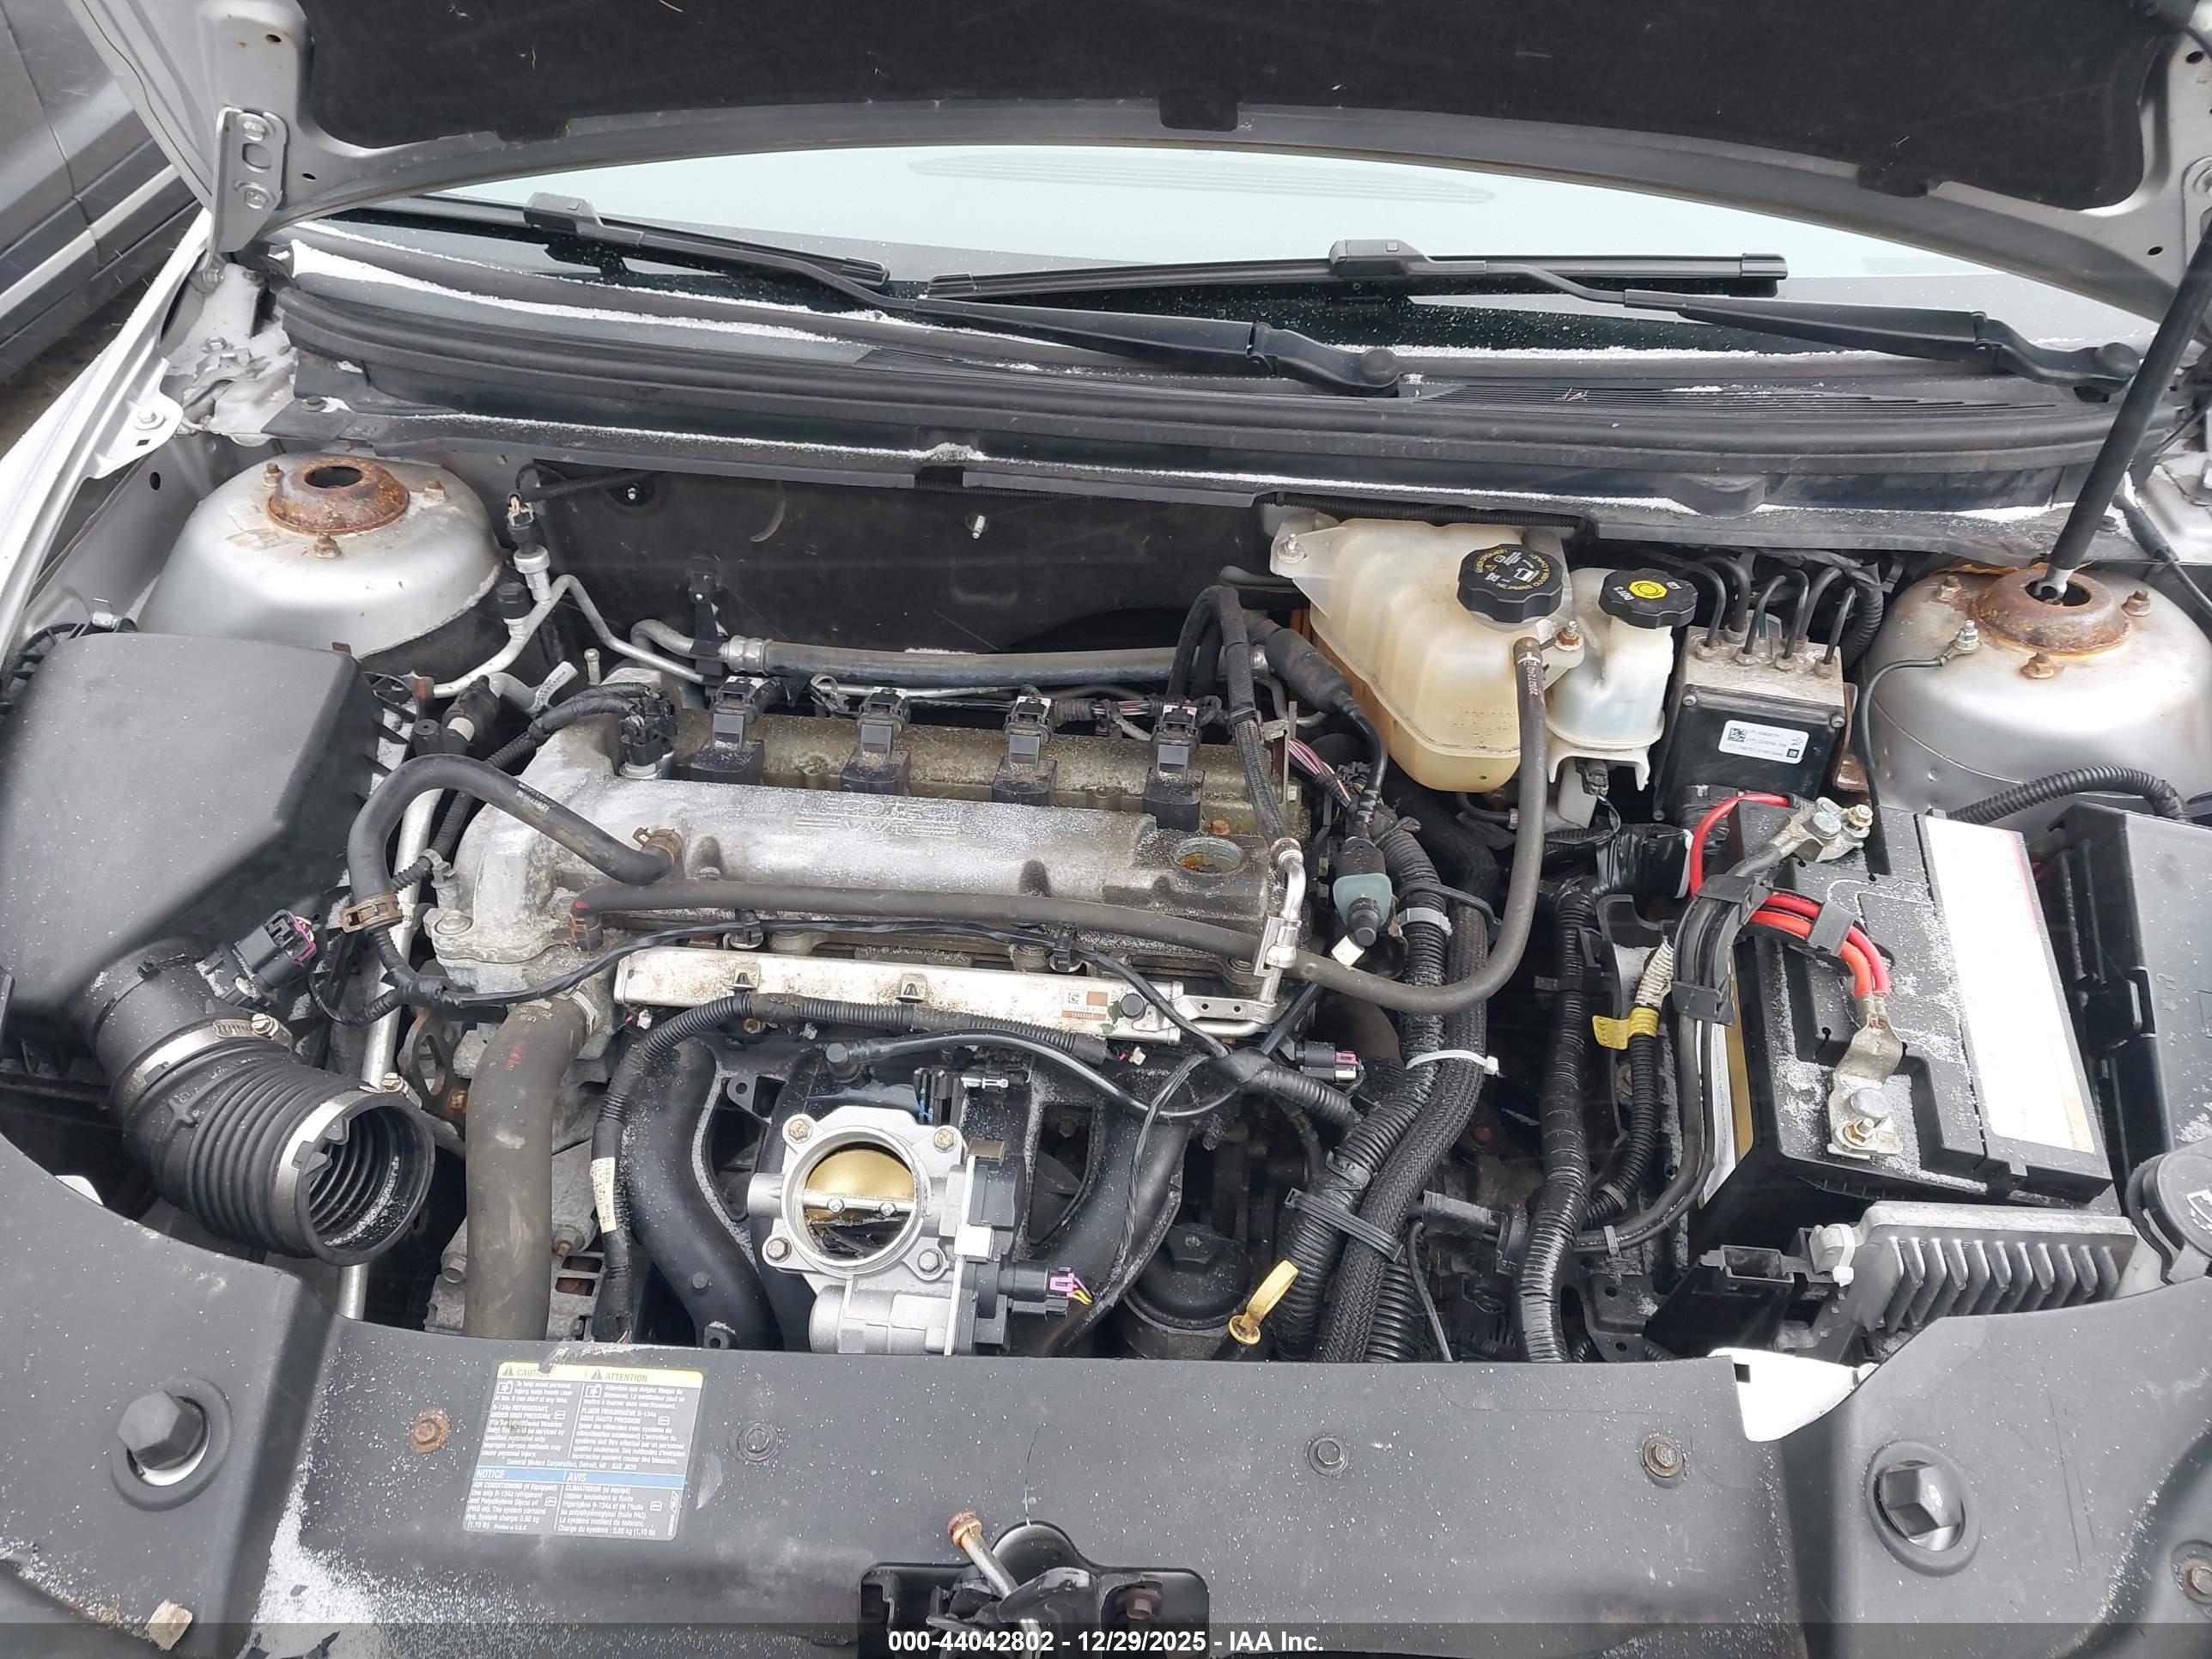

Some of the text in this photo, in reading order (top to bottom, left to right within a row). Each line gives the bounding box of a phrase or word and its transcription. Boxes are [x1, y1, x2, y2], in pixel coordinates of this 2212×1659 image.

[605, 1372, 647, 1382] ATTENTION
[477, 1468, 506, 1479] NOTICE
[567, 1472, 586, 1482] AVIS
